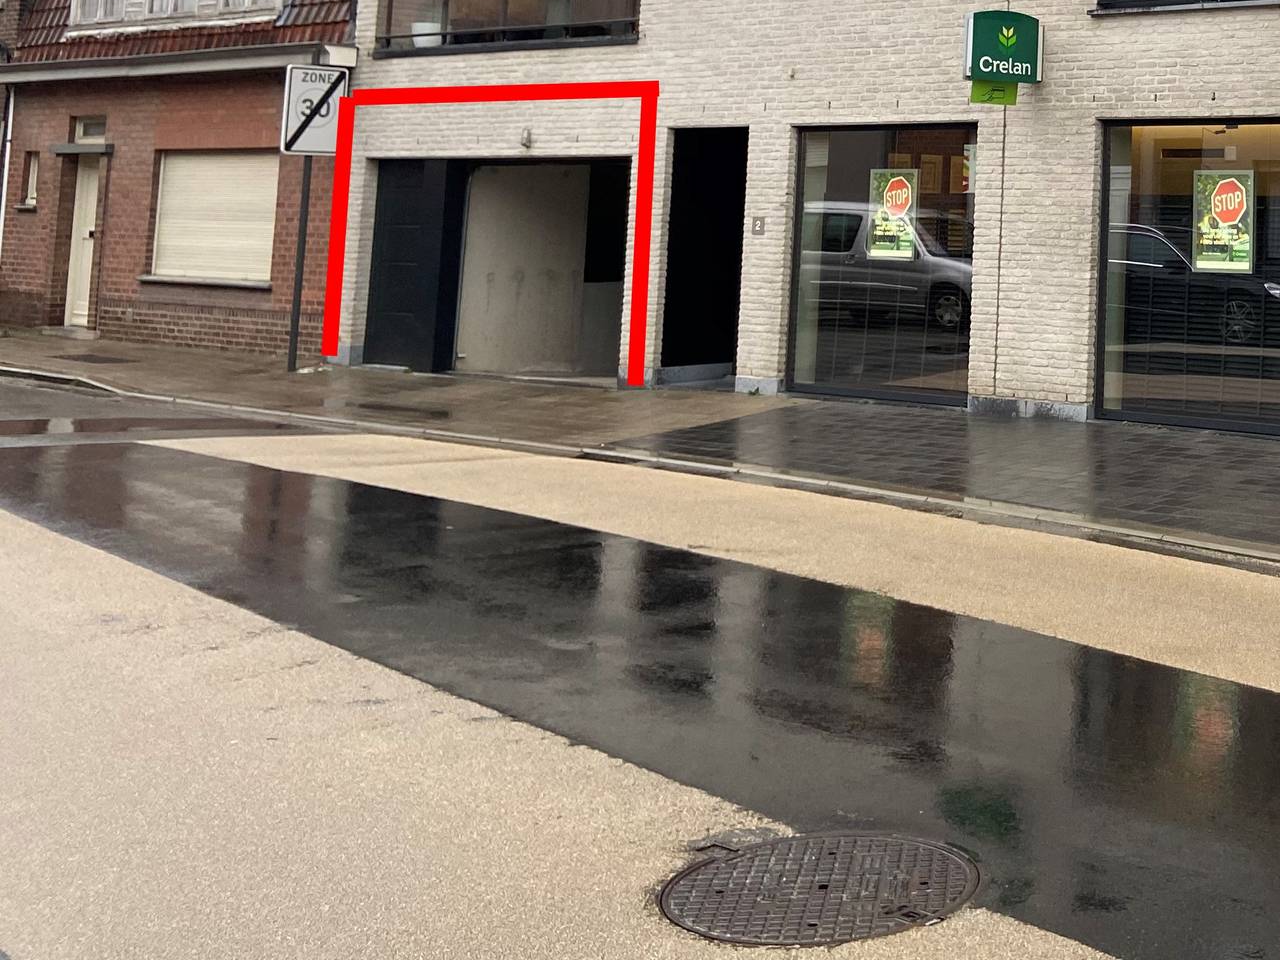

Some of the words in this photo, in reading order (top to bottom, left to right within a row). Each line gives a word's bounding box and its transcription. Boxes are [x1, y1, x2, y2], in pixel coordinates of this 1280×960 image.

[979, 56, 1031, 76] Crelan
[301, 71, 335, 84] ZONE
[300, 98, 331, 118] 30
[886, 188, 908, 208] STOP
[1214, 191, 1242, 213] STOP
[755, 220, 761, 231] 2
